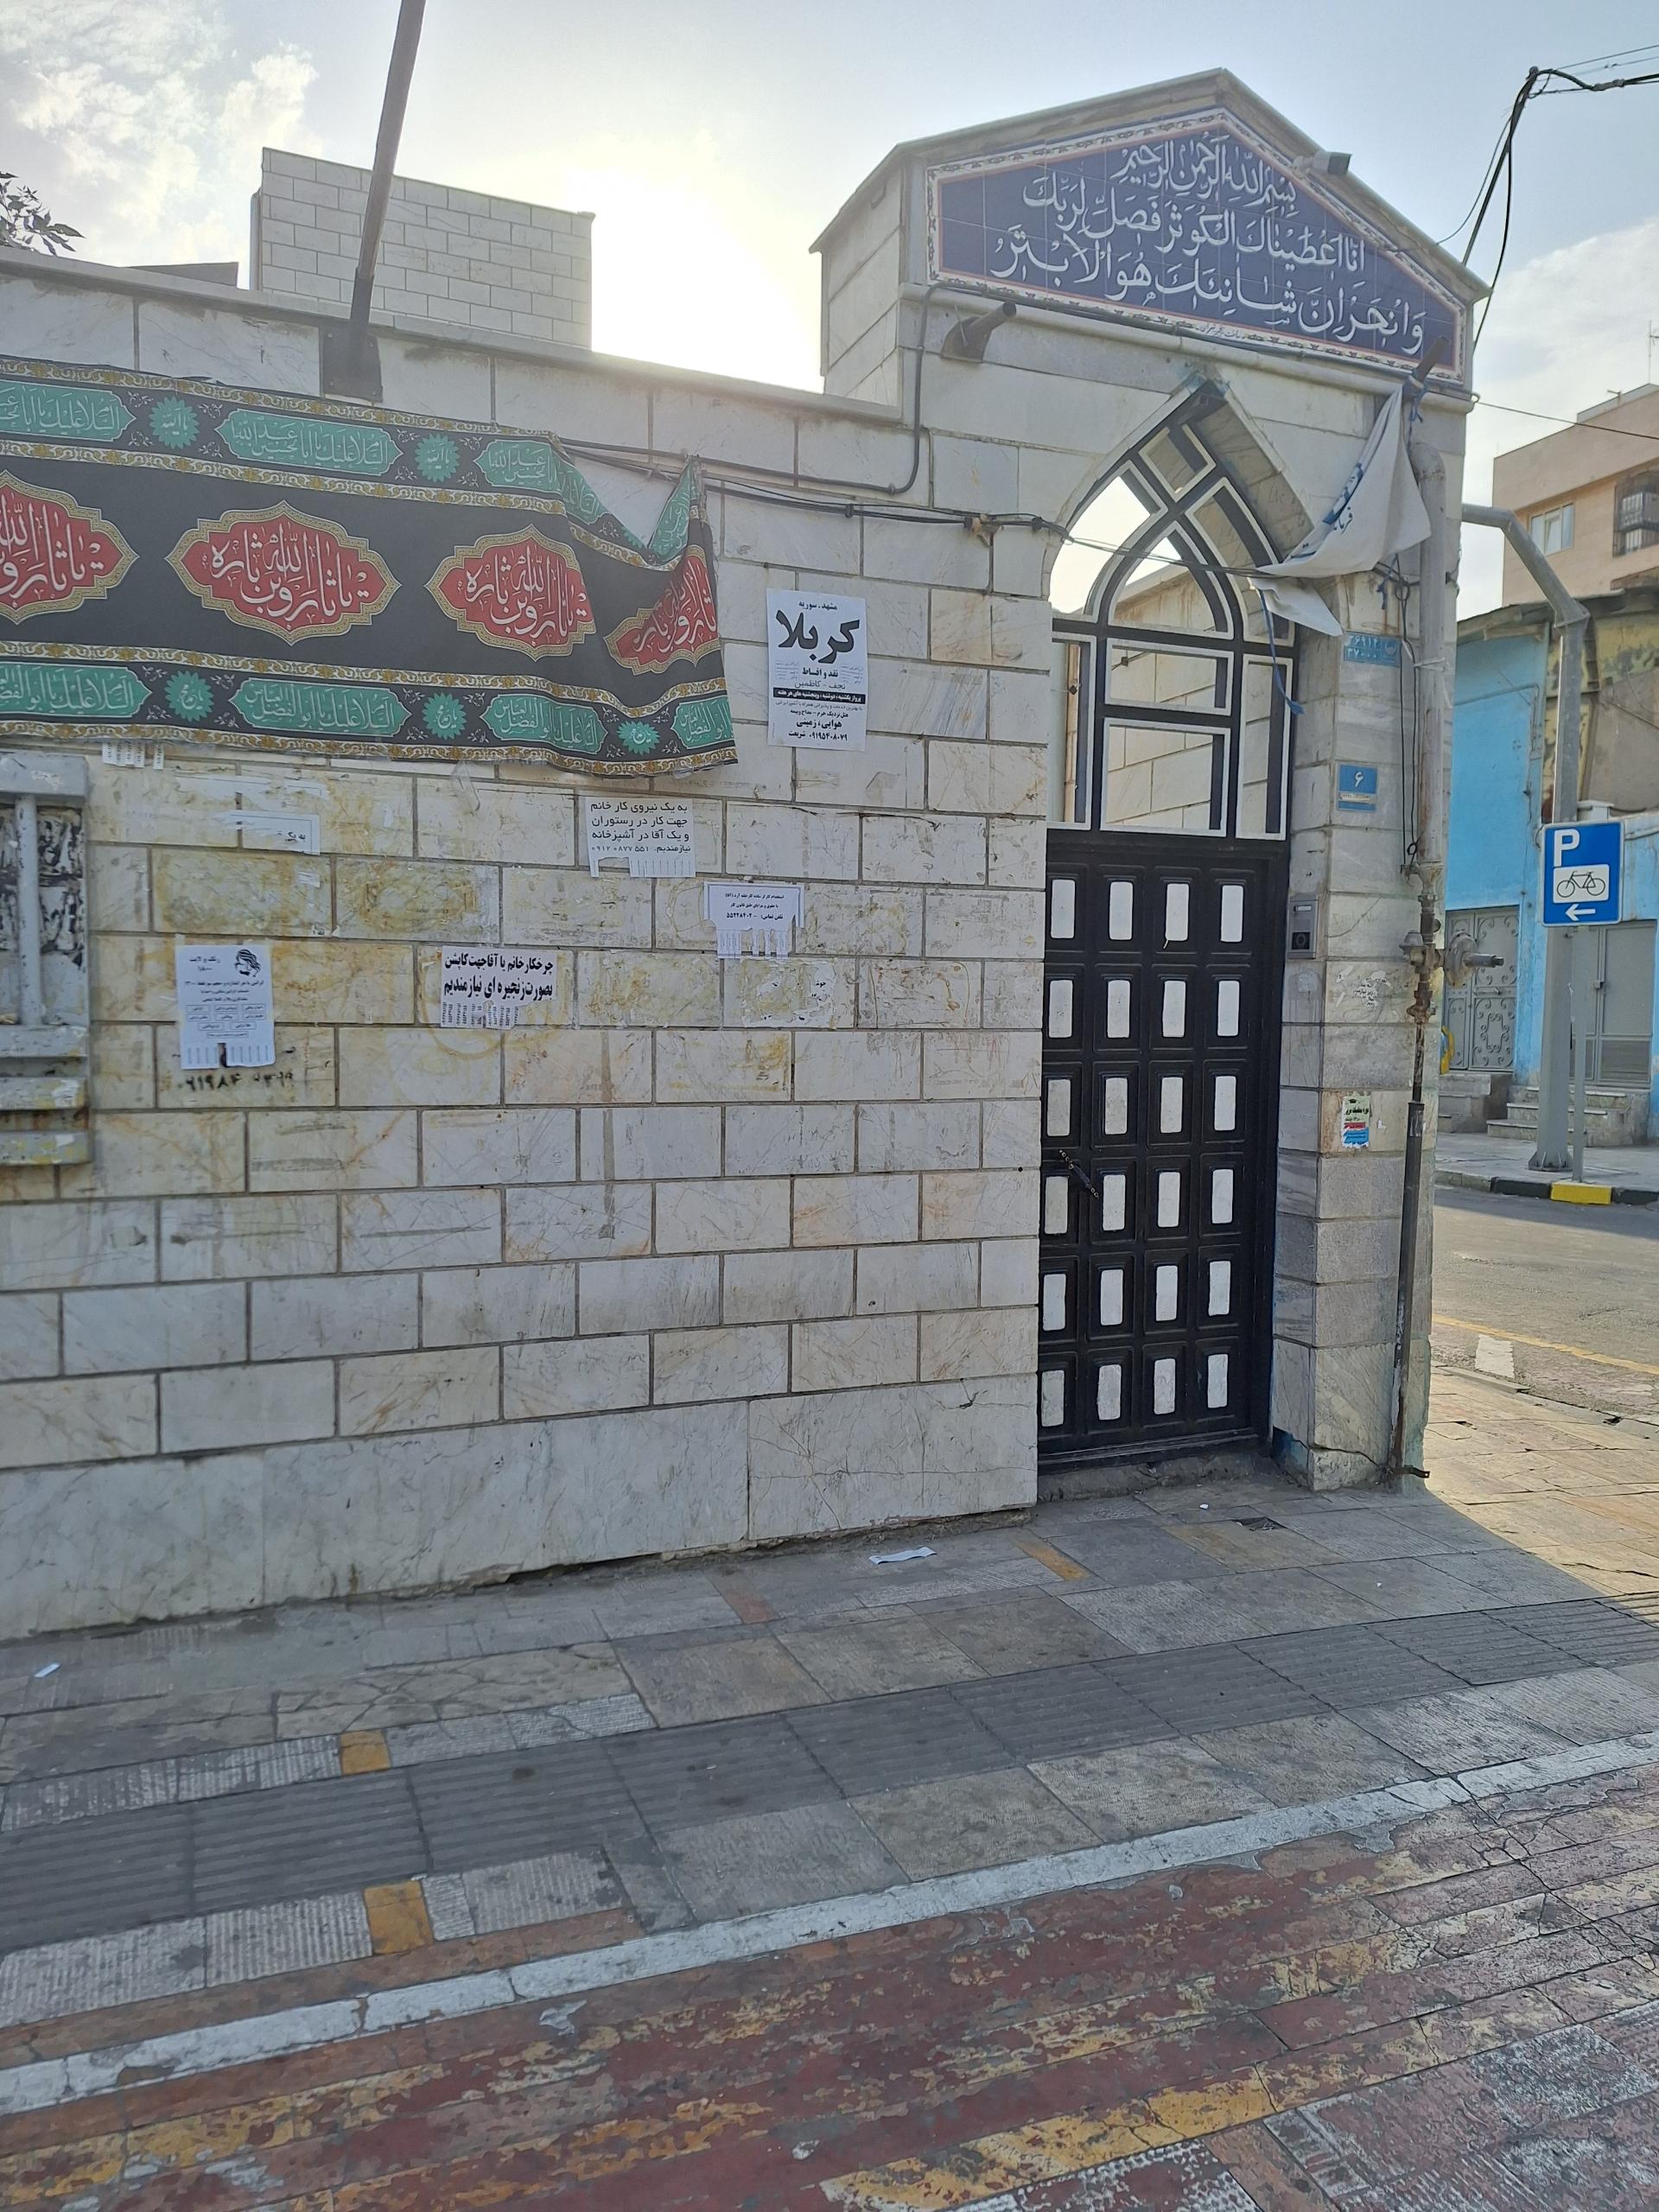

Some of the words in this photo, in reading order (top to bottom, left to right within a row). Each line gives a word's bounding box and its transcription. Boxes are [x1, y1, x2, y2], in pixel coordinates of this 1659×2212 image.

[775, 609, 860, 664] کربلا
[1354, 771, 1364, 788] ۶
[590, 800, 612, 812] خانم
[614, 801, 628, 813] کار
[630, 803, 658, 814] نیروی
[660, 802, 675, 814] یک
[677, 803, 688, 814] به
[591, 815, 633, 827] رستوران
[636, 818, 648, 828] در
[651, 816, 664, 828] کار
[666, 817, 688, 828] جهت
[591, 828, 635, 843] آشپزخانه
[638, 832, 649, 842] در
[652, 829, 664, 839] آقا
[666, 830, 681, 842] یک
[683, 833, 690, 842] و
[1553, 828, 1580, 868] P
[486, 953, 499, 968] آقا
[506, 955, 524, 973] خانم
